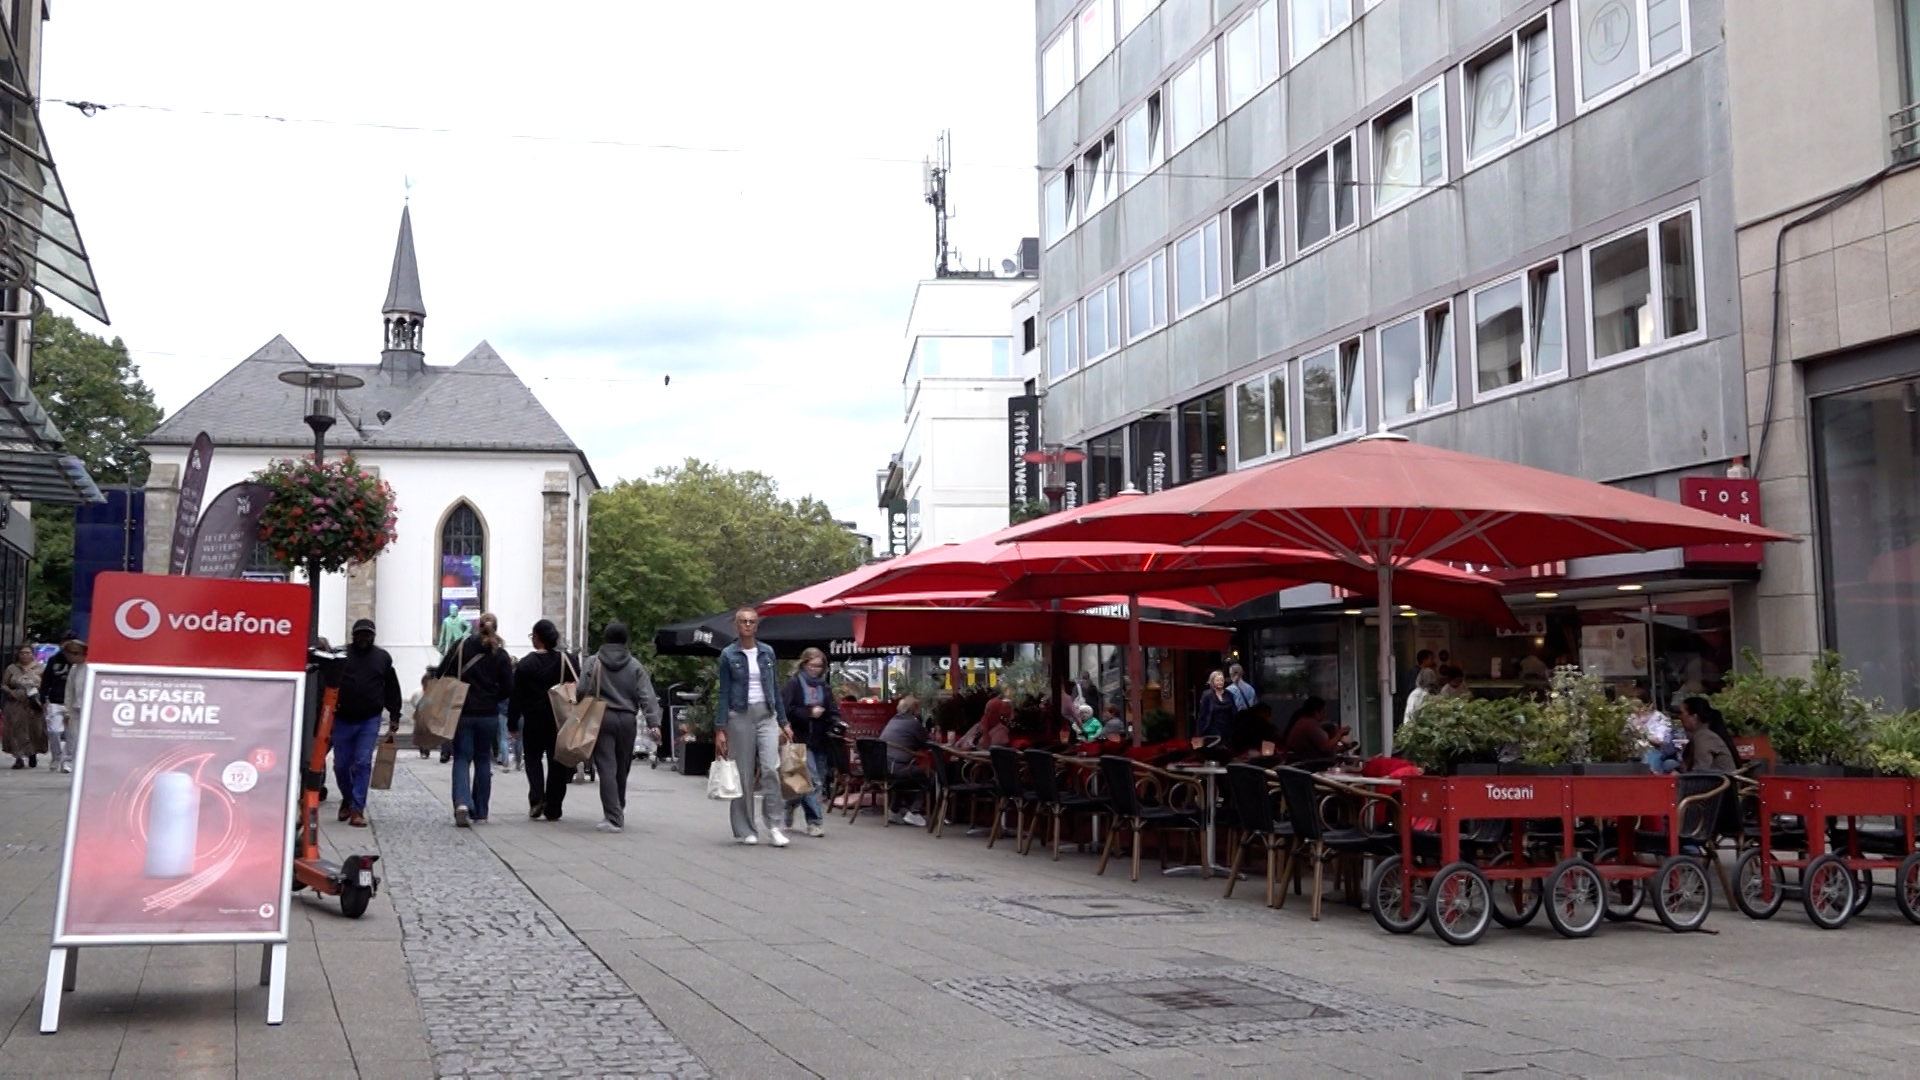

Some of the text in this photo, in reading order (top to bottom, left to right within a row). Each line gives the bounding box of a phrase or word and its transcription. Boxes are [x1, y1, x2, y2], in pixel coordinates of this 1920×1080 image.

[168, 609, 292, 636] vodafone
[99, 686, 206, 704] GLASFASER
[1485, 782, 1534, 800] Toscani
